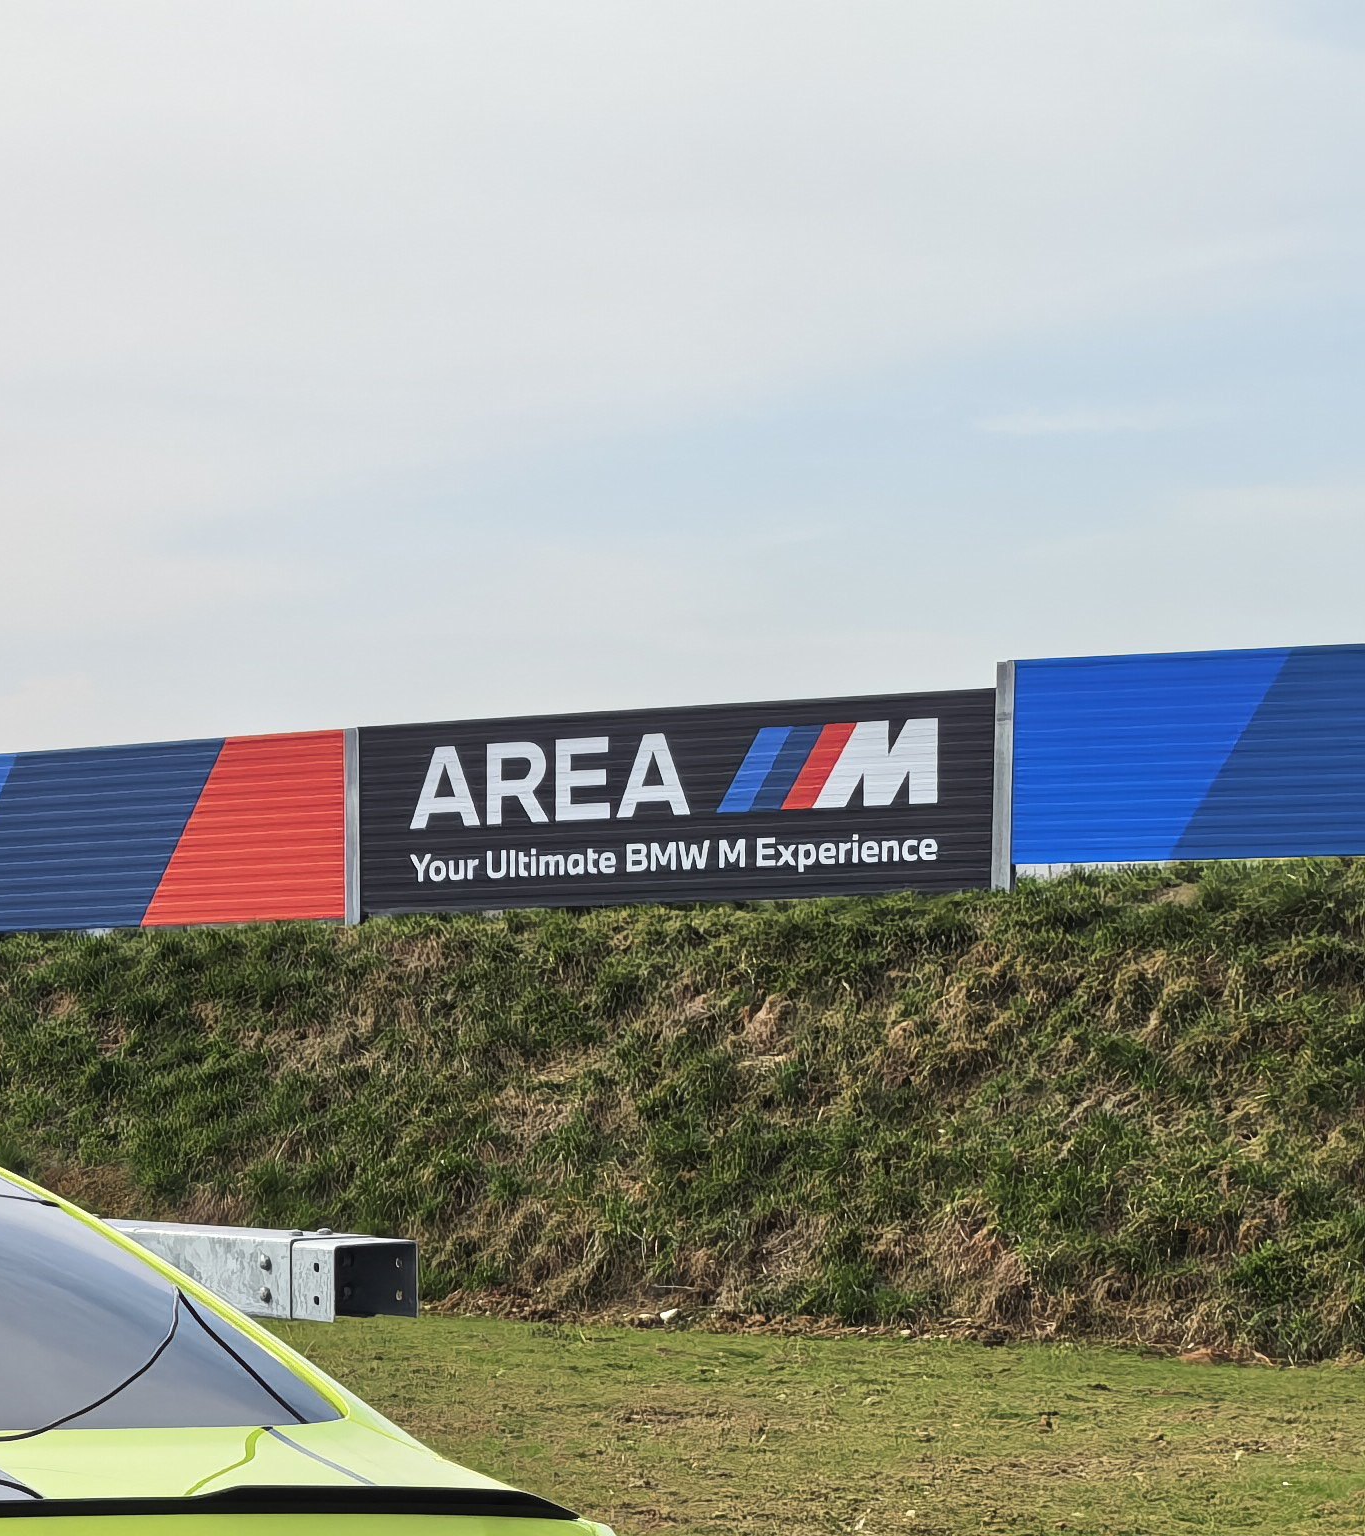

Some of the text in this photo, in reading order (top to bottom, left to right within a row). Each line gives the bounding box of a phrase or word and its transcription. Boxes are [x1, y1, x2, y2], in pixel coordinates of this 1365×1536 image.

[409, 733, 691, 830] AREA
[409, 834, 938, 883] Your Ultimate BMW M Experience
